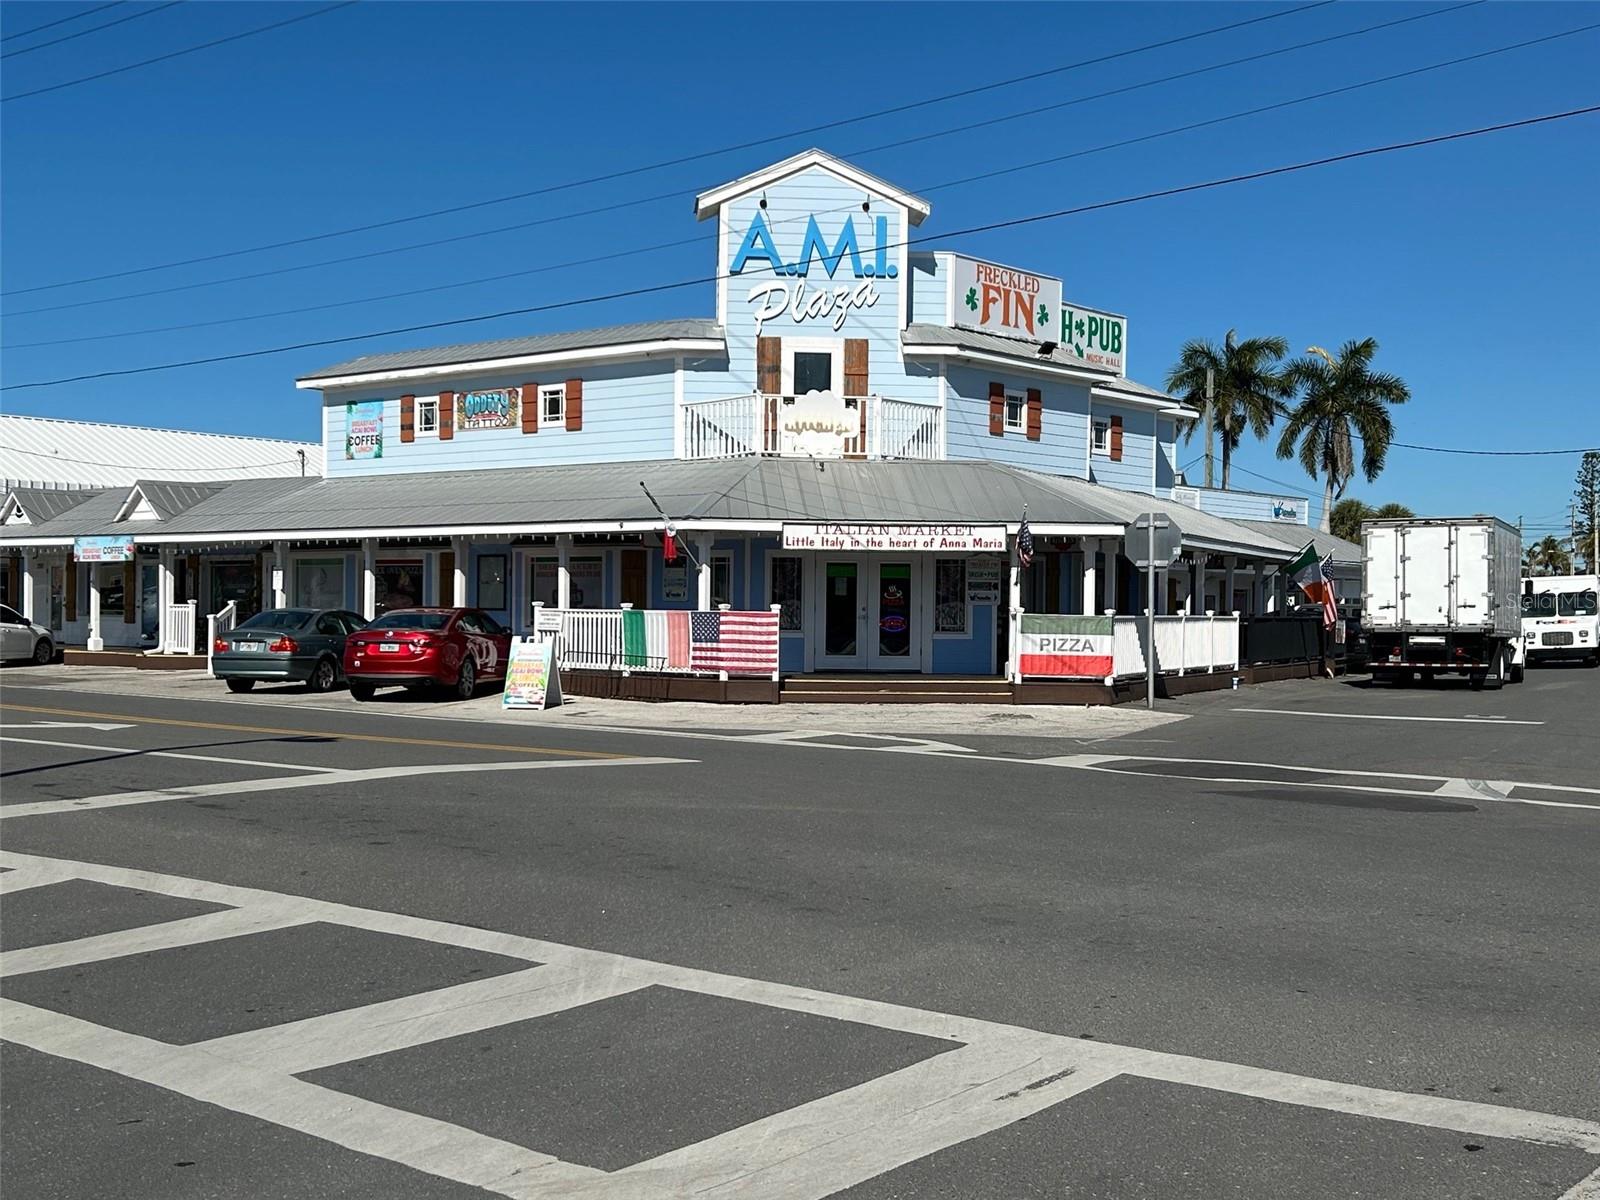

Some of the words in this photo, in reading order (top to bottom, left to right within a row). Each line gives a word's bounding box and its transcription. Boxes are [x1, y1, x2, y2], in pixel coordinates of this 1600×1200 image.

[729, 210, 899, 280] A.M.I.
[976, 263, 1040, 294] FRECKLED
[748, 276, 880, 337] Plaza
[979, 281, 1036, 337] FIN
[1087, 315, 1122, 354] PUB
[1086, 353, 1104, 365] MUSIC
[1106, 357, 1121, 368] HALL
[348, 434, 381, 446] COFFEE
[815, 525, 890, 535] ITALIAN
[897, 526, 976, 536] MARKET
[785, 536, 815, 547] Little
[821, 536, 844, 549] Italy
[851, 539, 860, 547] in
[866, 537, 883, 547] the
[889, 537, 917, 548] heart
[923, 537, 935, 548] of
[940, 538, 967, 548] Anna
[973, 538, 1003, 548] Maria
[103, 546, 124, 555] COFFEE
[1040, 638, 1094, 653] PIZZA
